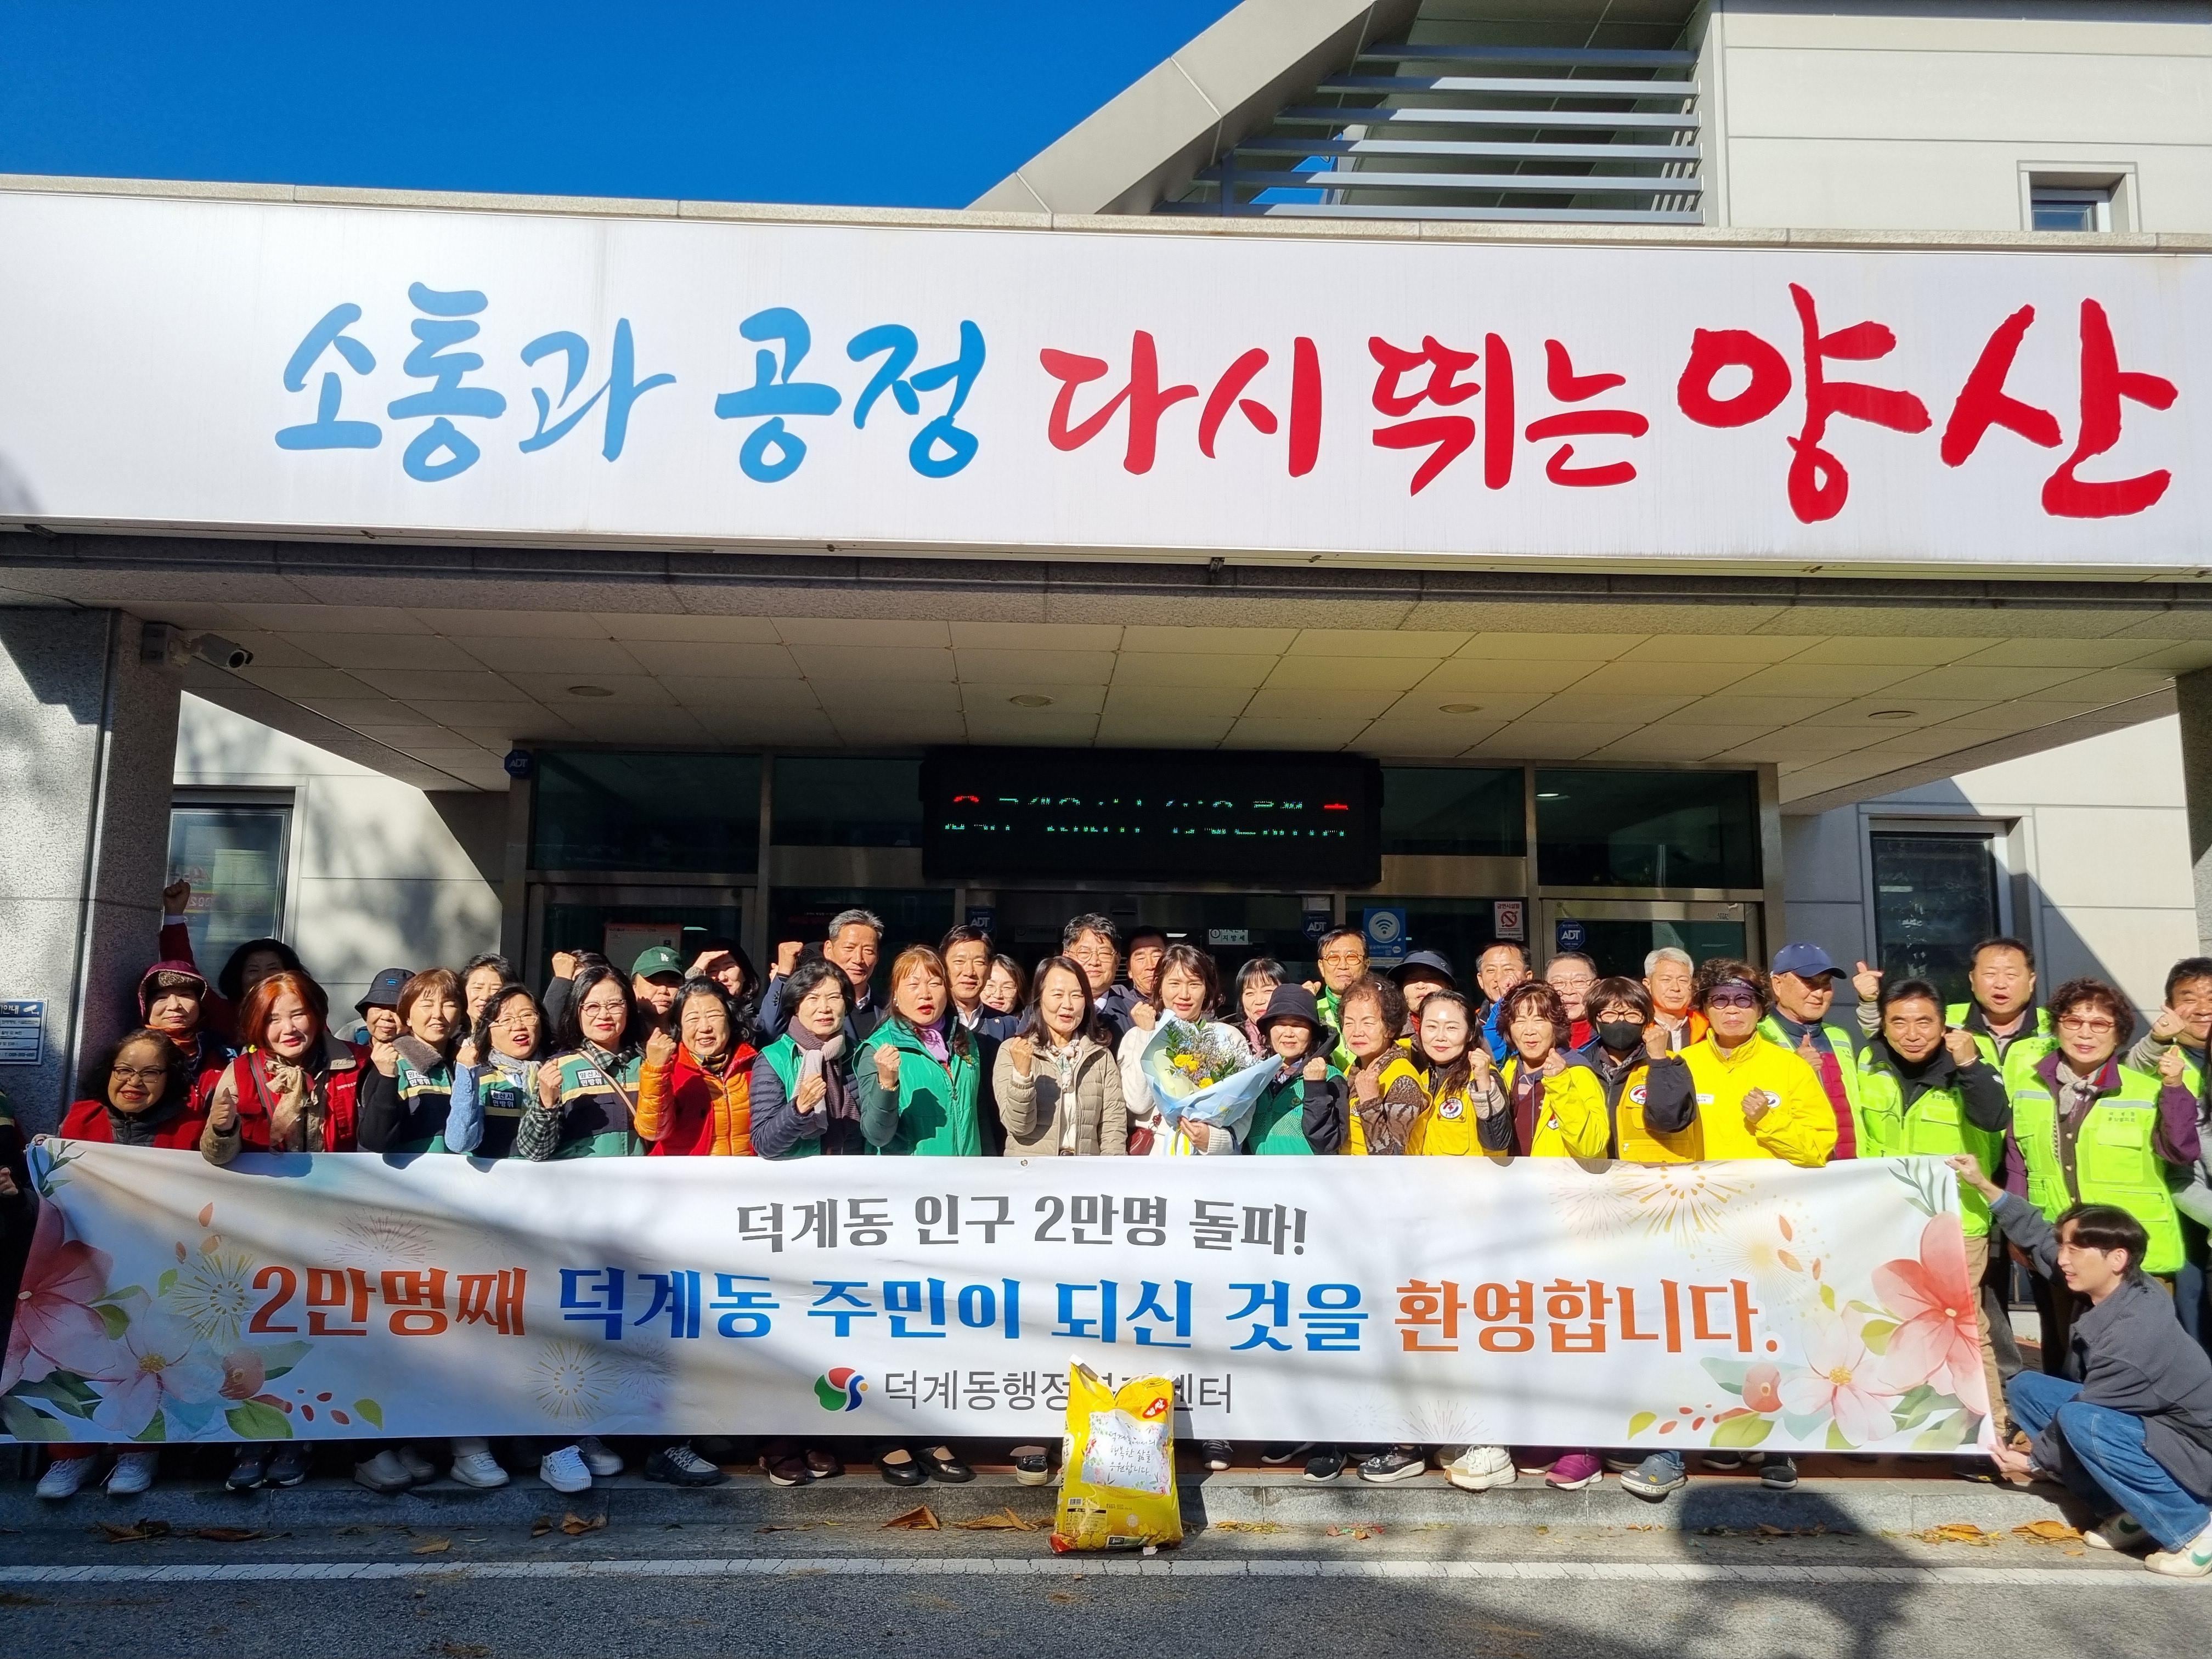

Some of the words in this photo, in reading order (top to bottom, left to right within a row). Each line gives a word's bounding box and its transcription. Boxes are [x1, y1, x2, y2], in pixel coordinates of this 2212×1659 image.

[277, 282, 674, 481] 소통과
[715, 308, 986, 482] 공정
[1041, 330, 1322, 477] 다시
[1369, 333, 1649, 496] 뛰는
[1678, 283, 2179, 524] 양산
[509, 759, 528, 768] ADT
[970, 917, 990, 928] ADT
[1307, 922, 1327, 932] ADT
[1561, 930, 1581, 940] ADT
[660, 952, 669, 961] LA
[739, 1198, 893, 1252] 덕계동
[915, 1194, 1014, 1245] 인구
[1035, 1194, 1167, 1246] 2만명
[1189, 1198, 1307, 1255] 돌파!
[250, 1267, 525, 1335] 2만명째
[560, 1268, 780, 1340] 덕계동
[808, 1278, 1020, 1339] 주민이
[1052, 1279, 1193, 1348] 되신
[1226, 1280, 1369, 1352] 것을
[1395, 1279, 1778, 1352] 환영합니다.
[1110, 1445, 1135, 1460] 행복한
[1137, 1448, 1152, 1463] 삶을
[1109, 1461, 1152, 1476] 응원합니다.
